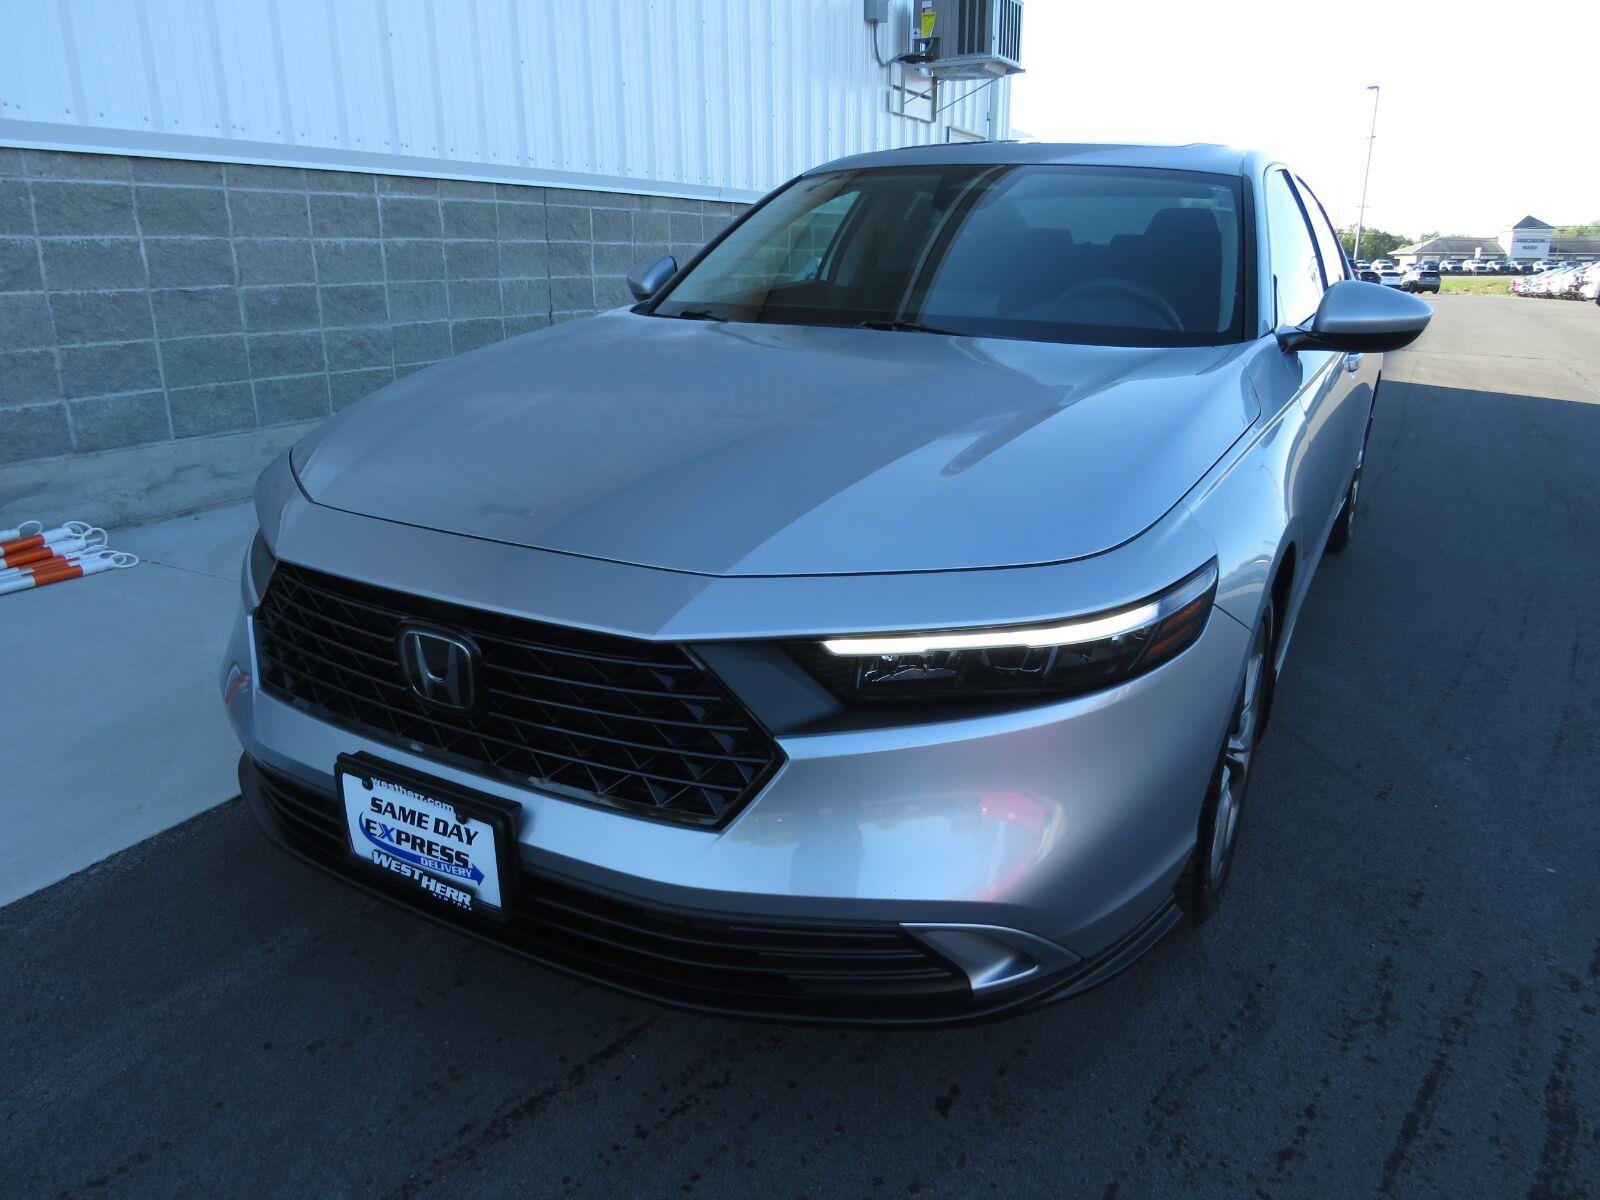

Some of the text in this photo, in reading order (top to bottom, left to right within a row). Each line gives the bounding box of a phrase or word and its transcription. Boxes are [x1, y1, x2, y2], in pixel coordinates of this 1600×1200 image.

[371, 777, 455, 812] westherr.com
[370, 797, 479, 846] SAME DAY
[364, 818, 471, 868] EXPRESS
[420, 857, 472, 878] DELIVERY
